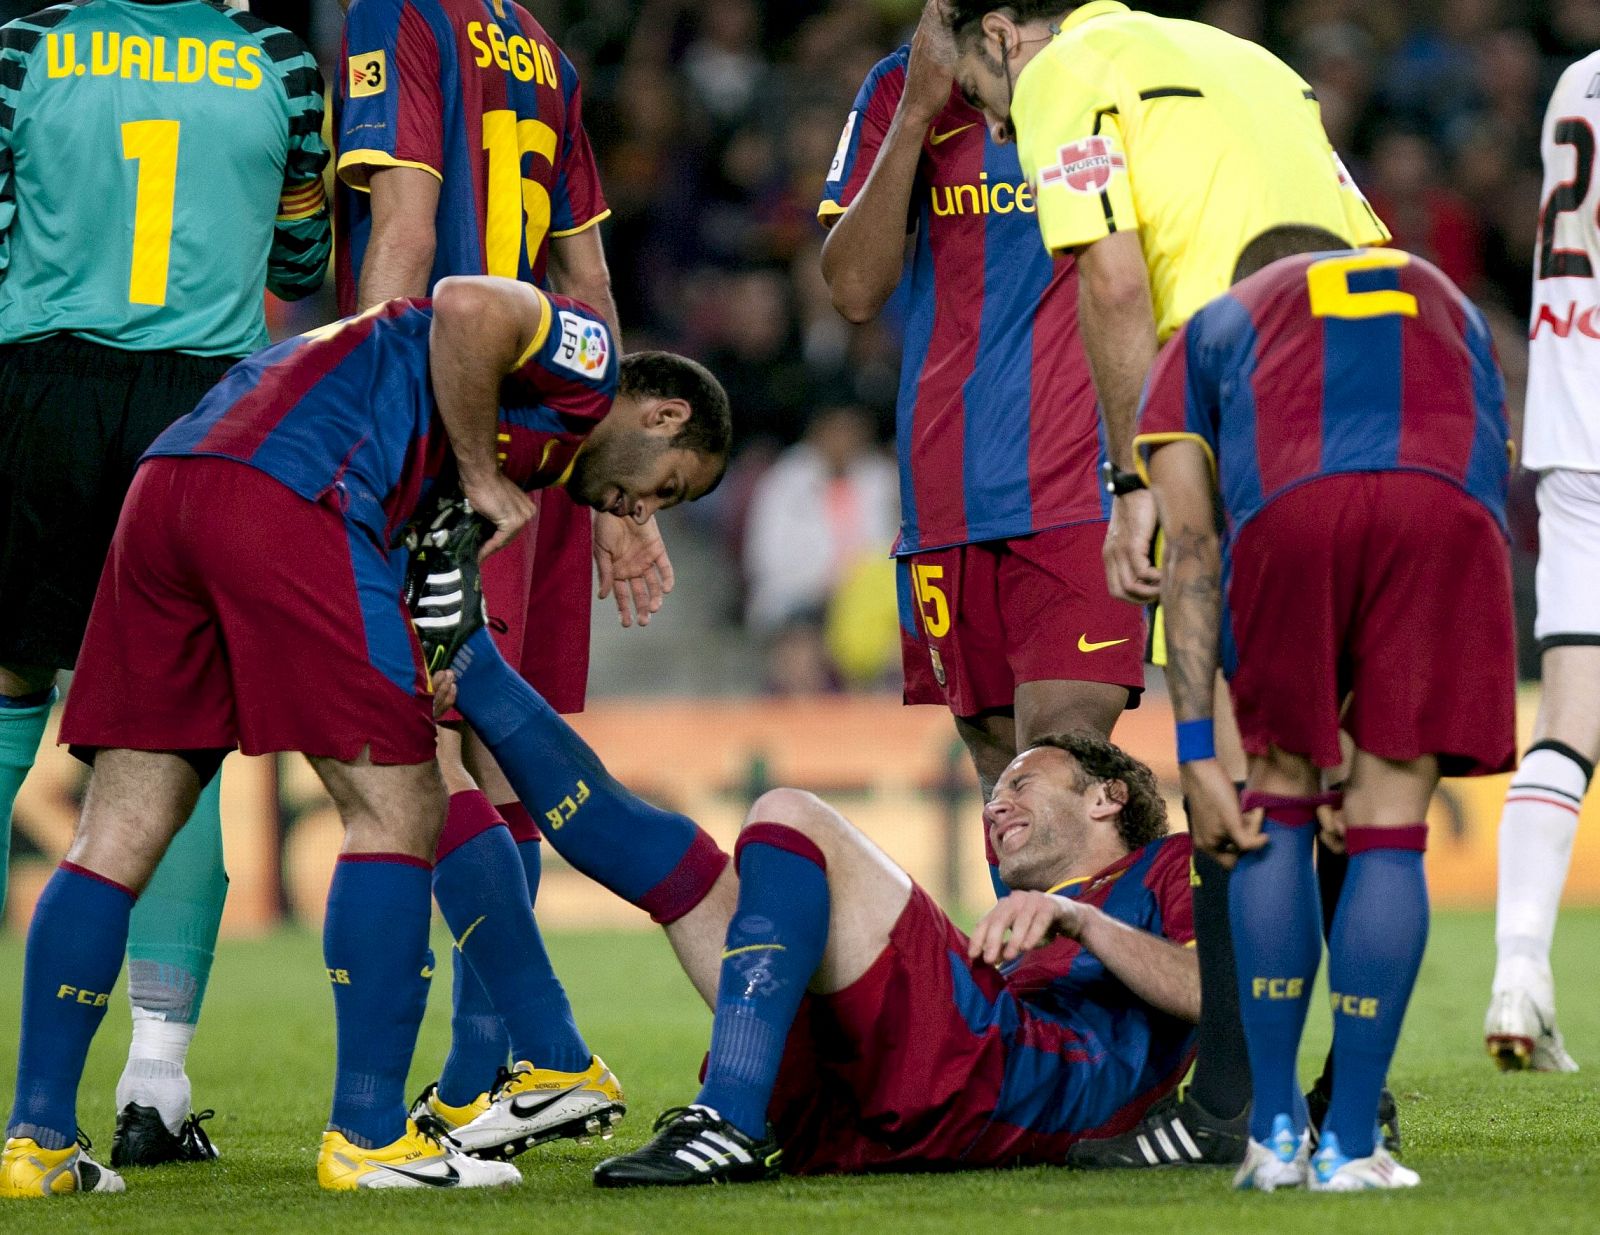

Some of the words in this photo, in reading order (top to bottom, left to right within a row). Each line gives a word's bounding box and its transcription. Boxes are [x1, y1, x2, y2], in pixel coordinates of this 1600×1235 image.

[365, 60, 382, 88] 3
[120, 119, 180, 306] 1
[482, 108, 558, 281] 16
[1538, 115, 1600, 280] 2
[561, 317, 578, 360] LFP
[544, 779, 591, 831] FCB
[56, 983, 110, 1007] FCB
[1252, 977, 1304, 1000] FCB
